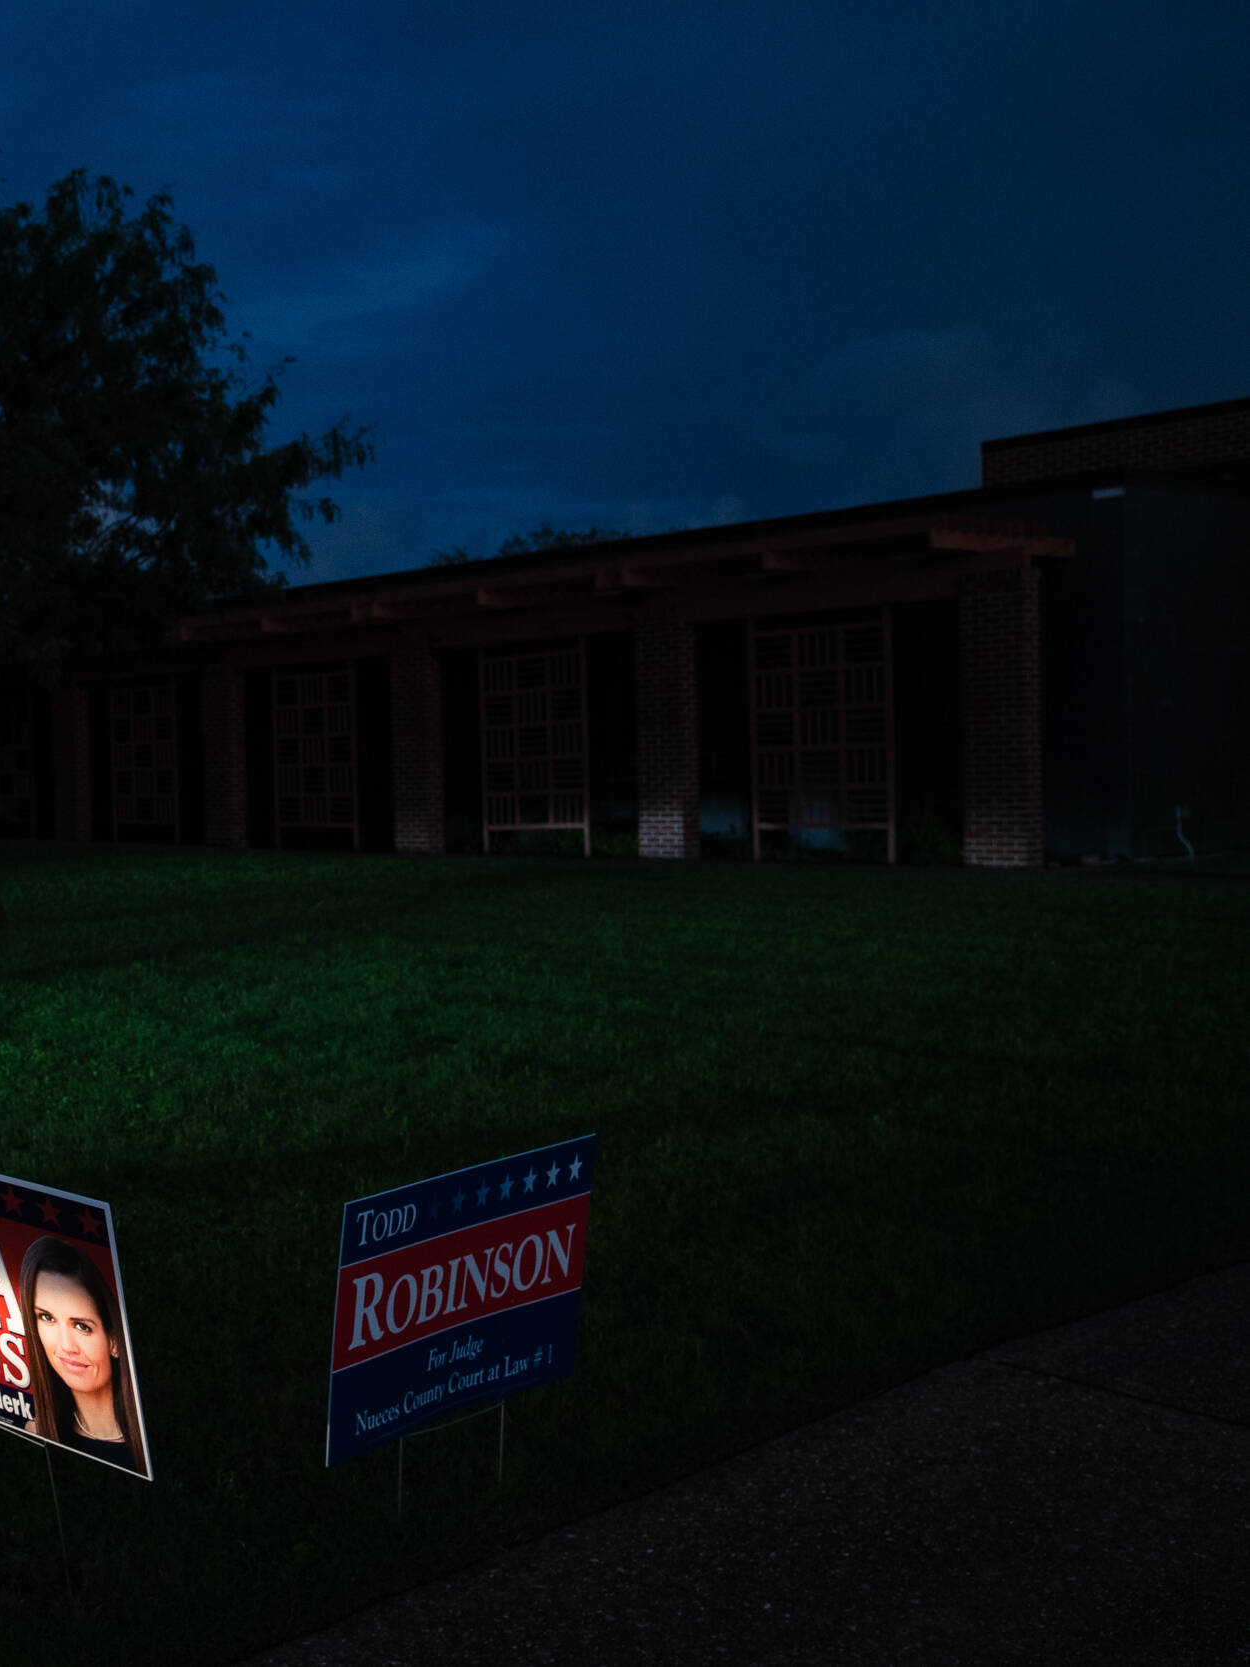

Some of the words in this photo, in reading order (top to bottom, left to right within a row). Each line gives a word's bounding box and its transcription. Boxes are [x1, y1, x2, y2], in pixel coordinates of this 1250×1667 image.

[347, 1223, 577, 1351] ROBINSON
[425, 1346, 448, 1372] For
[448, 1335, 485, 1365] Judge
[354, 1402, 401, 1437] Nueces
[402, 1381, 446, 1415] County
[447, 1370, 485, 1395] Court
[487, 1364, 500, 1382] at
[503, 1354, 531, 1379] Law
